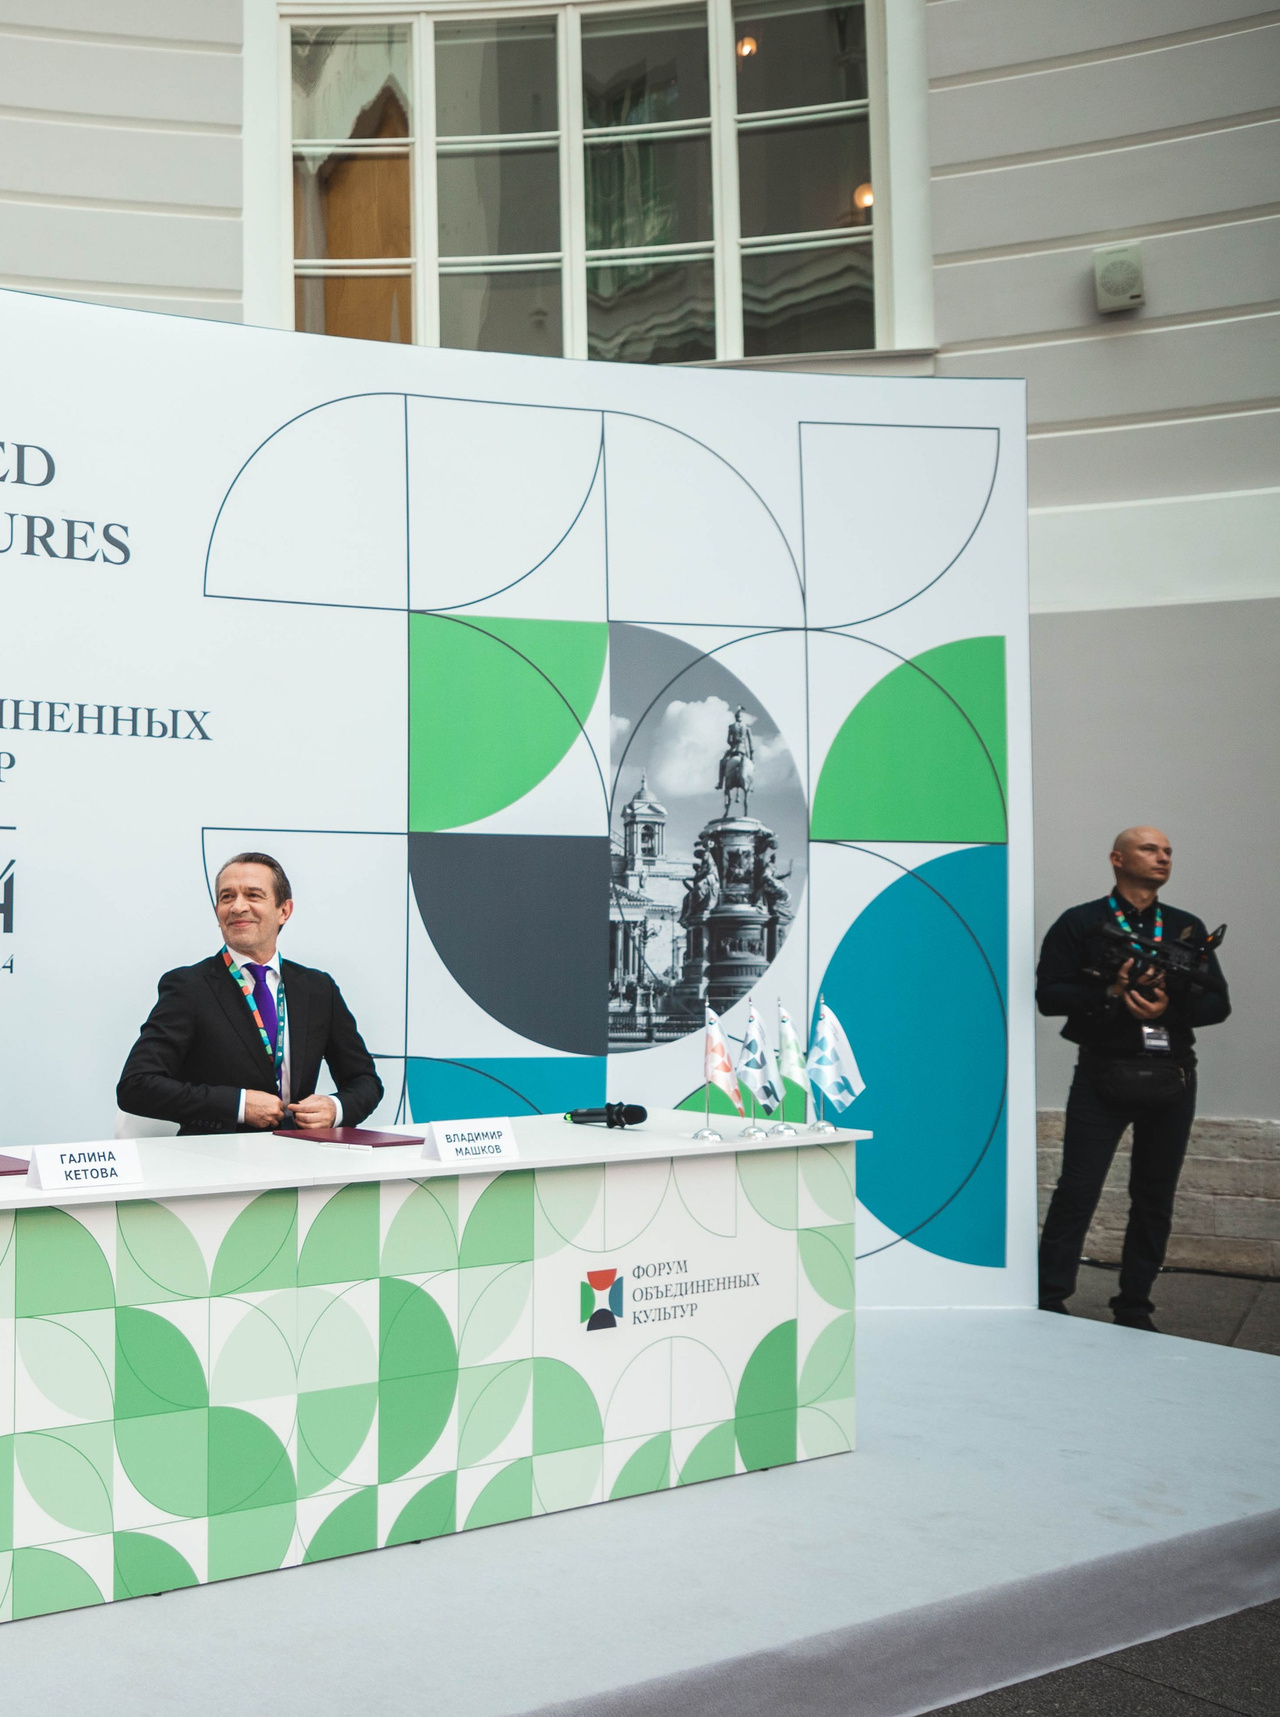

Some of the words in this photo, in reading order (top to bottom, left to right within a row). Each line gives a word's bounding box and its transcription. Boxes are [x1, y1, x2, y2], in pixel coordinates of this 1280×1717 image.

[445, 1130, 503, 1144] ВЛАДИМИР
[59, 1150, 117, 1165] ГАЛИНА
[455, 1144, 502, 1157] МАШКОВ
[64, 1166, 119, 1181] КЕТОВА
[631, 1259, 689, 1280] ФОРУМ
[631, 1272, 761, 1303] ОБЪЕДИНЕННЫХ
[631, 1302, 699, 1326] КУЛЬТУР
